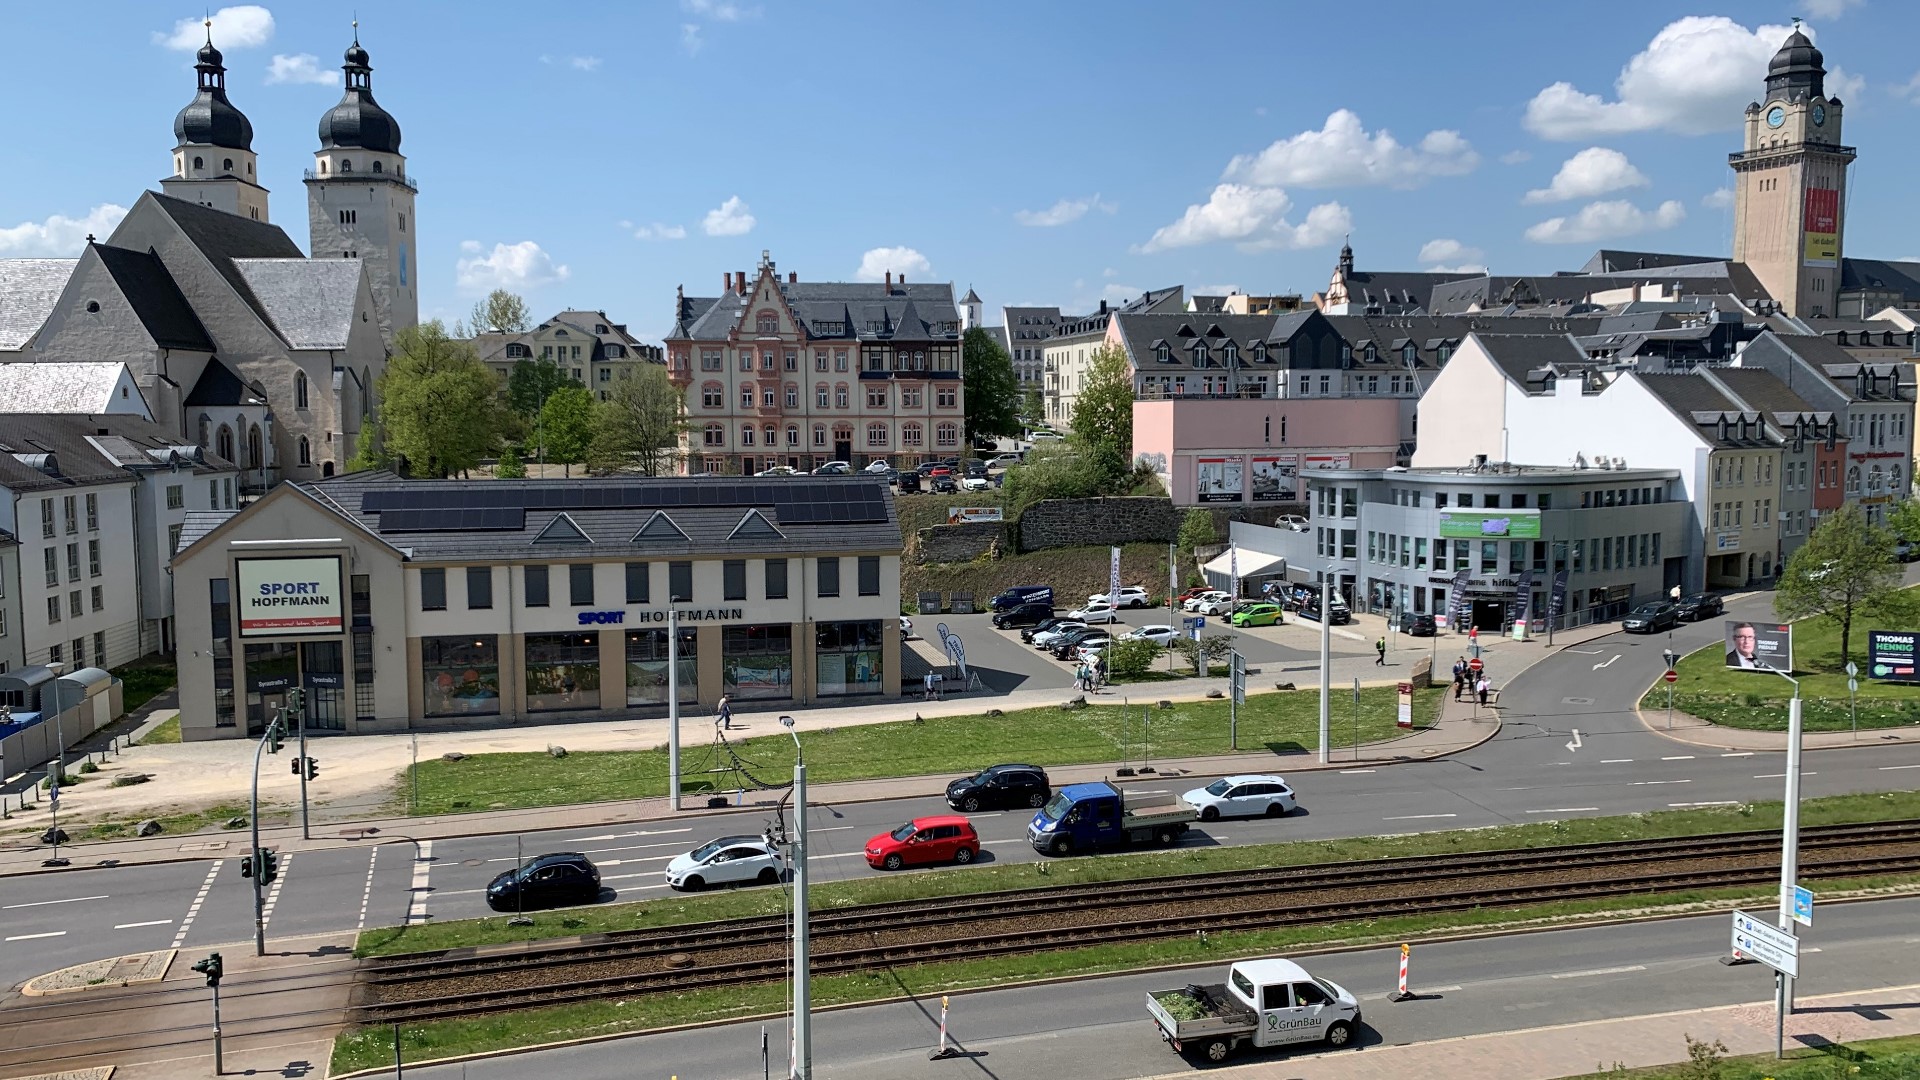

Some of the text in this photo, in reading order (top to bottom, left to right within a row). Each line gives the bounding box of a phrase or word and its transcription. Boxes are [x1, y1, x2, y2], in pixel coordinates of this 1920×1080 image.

[260, 582, 319, 595] SPORT
[252, 596, 329, 607] HOPFMANN
[578, 609, 742, 625] SPORT HOFMANN
[1876, 635, 1914, 643] THOMAS
[1876, 643, 1914, 651] HENNIG
[1279, 1017, 1322, 1029] GrünBau
